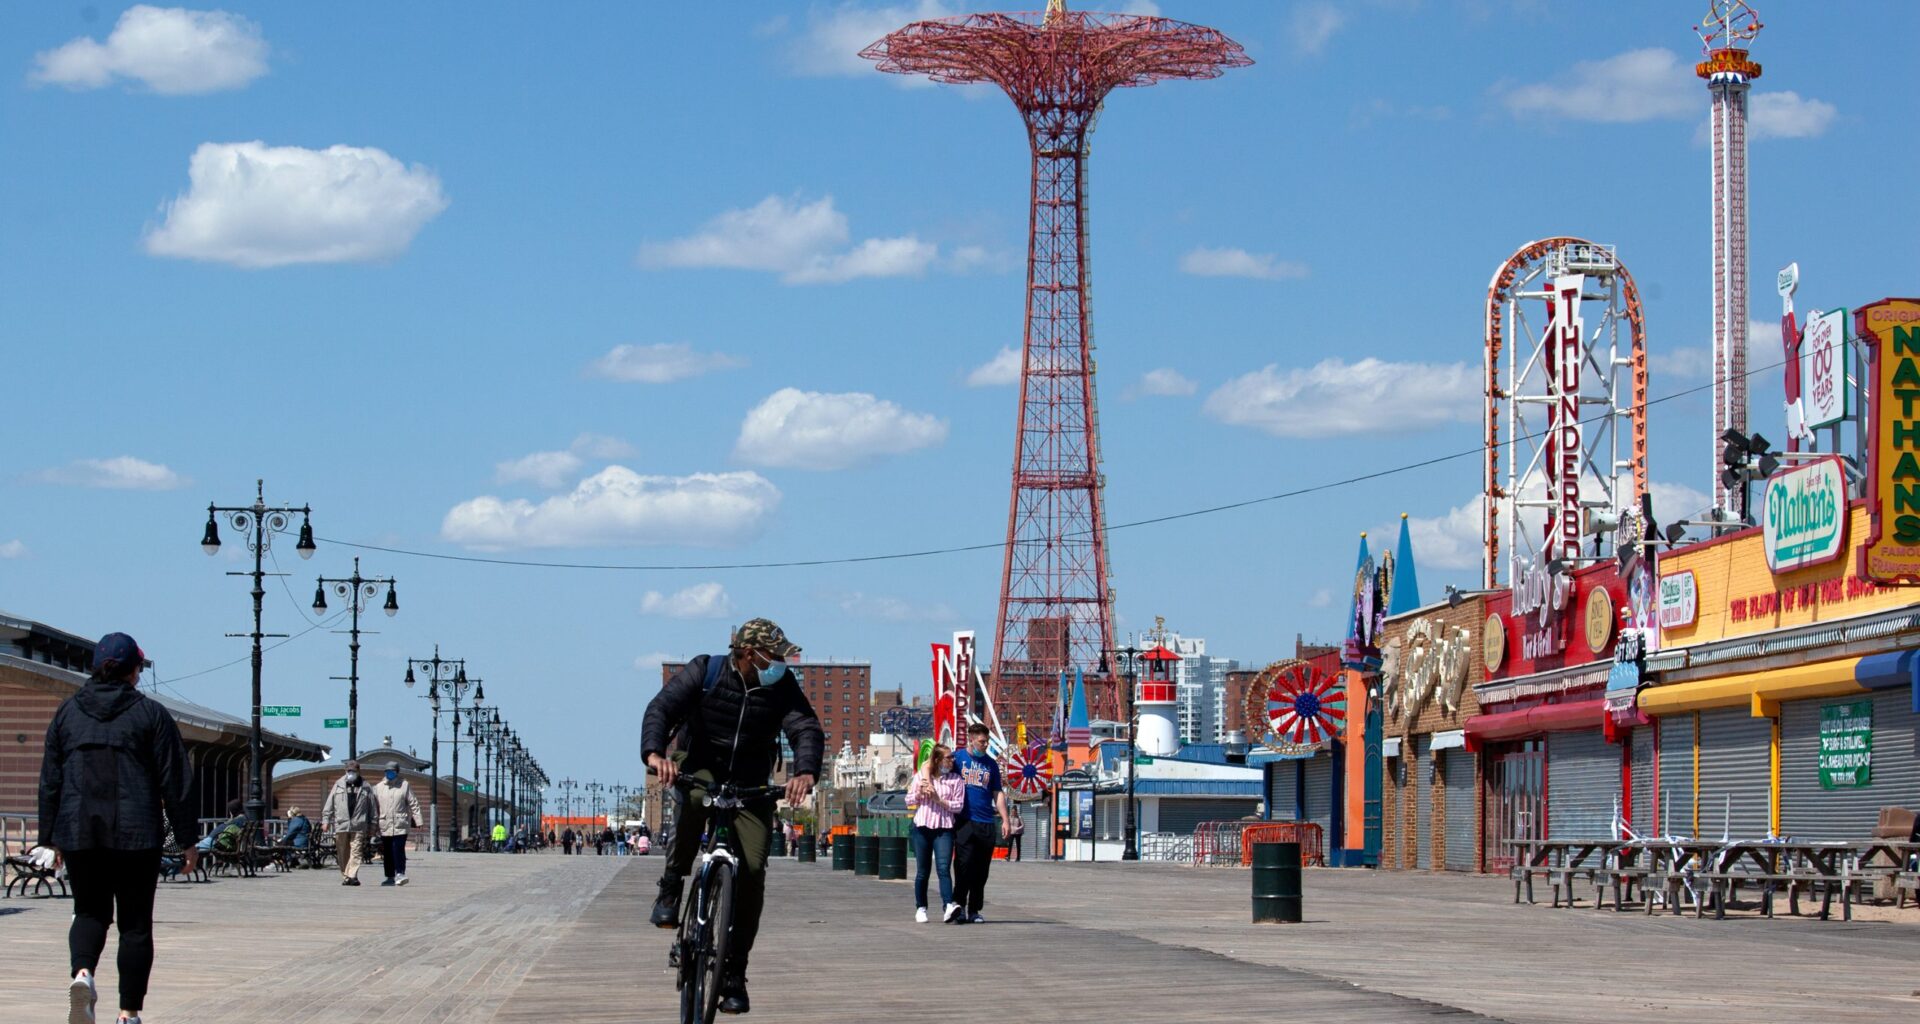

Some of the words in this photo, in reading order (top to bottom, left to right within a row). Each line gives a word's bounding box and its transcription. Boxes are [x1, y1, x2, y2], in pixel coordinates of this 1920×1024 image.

[1812, 340, 1833, 386] 100
[1812, 374, 1833, 407] YEARS
[1769, 472, 1836, 541] Nathan's
[1730, 598, 1747, 624] THE
[1783, 586, 1795, 613] OF
[1820, 577, 1844, 605] YORK
[263, 706, 279, 715] Ruby
